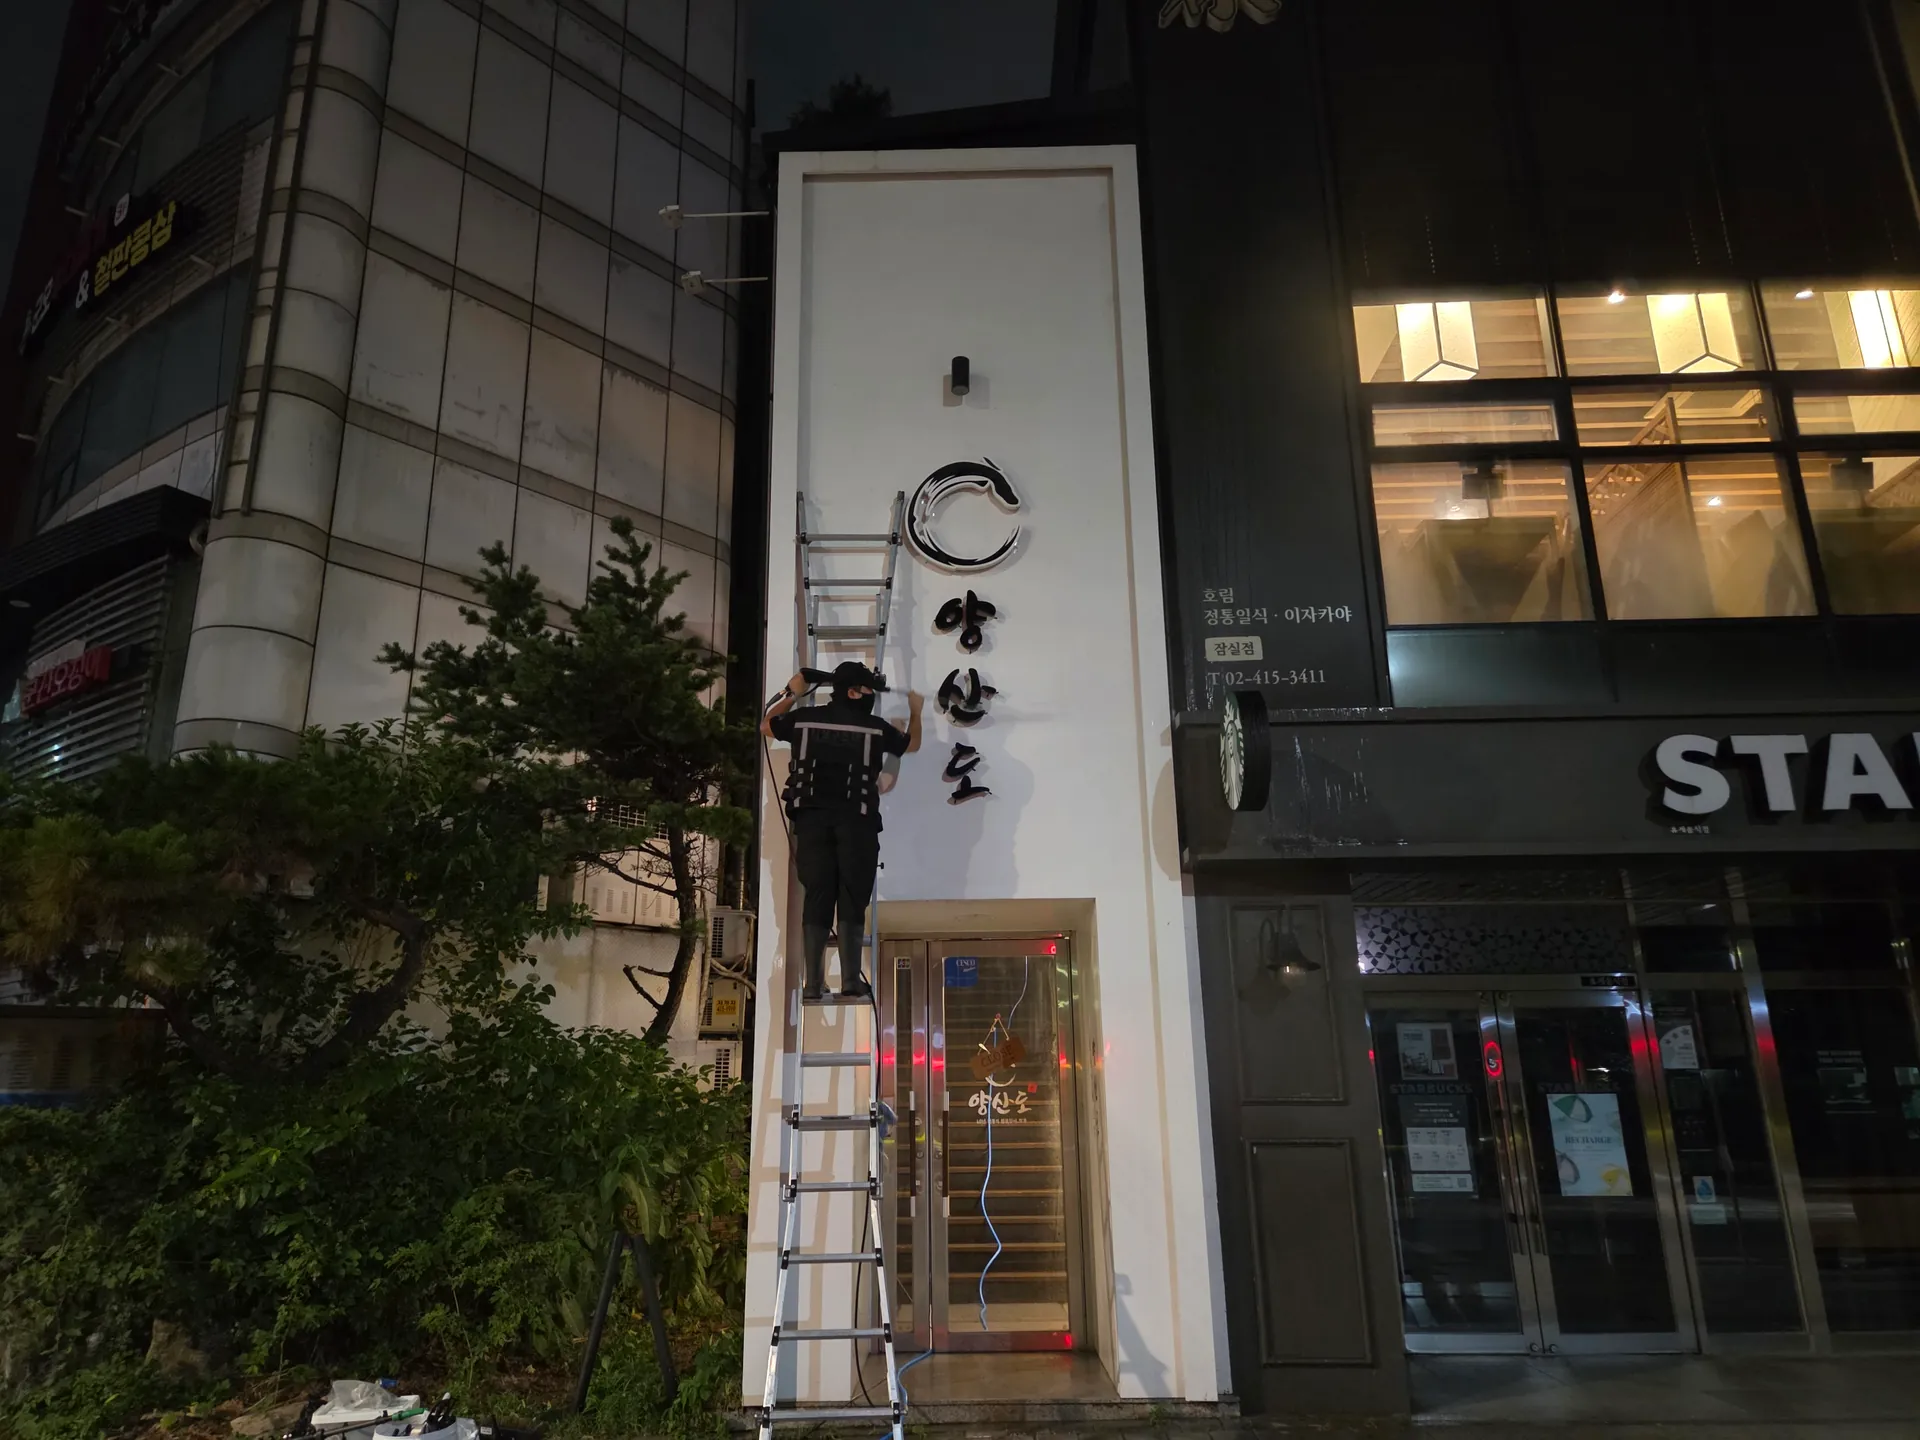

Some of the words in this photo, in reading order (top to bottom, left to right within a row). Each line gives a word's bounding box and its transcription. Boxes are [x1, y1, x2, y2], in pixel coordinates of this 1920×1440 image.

[1203, 588, 1235, 604] 호림
[1204, 607, 1268, 626] 정통일식
[1284, 605, 1353, 624] 이자카야
[1214, 641, 1255, 656] 잠실점
[1225, 668, 1327, 685] 02-415-3411
[934, 589, 998, 799] 양산도
[1656, 732, 1920, 815] STA
[981, 1045, 1013, 1068] CLOSE
[1388, 1083, 1474, 1094] STARBUCKS
[968, 1089, 1032, 1116] 양산도
